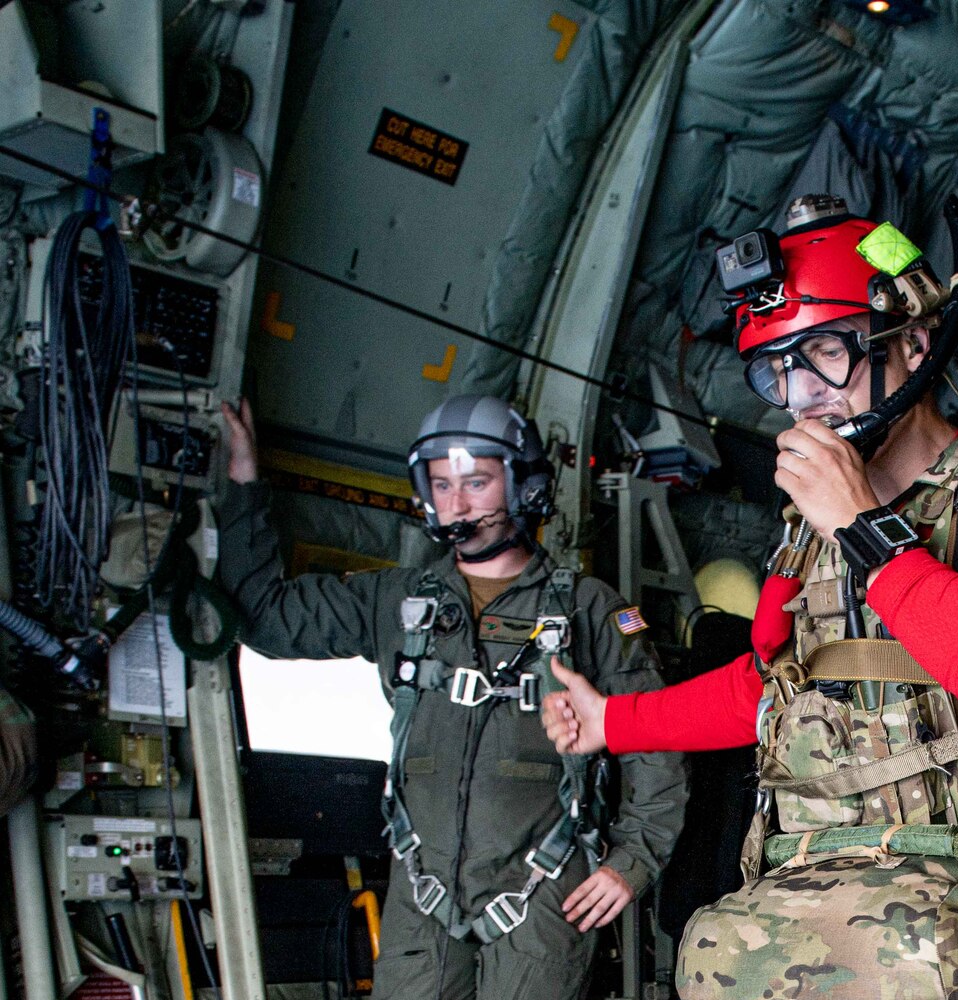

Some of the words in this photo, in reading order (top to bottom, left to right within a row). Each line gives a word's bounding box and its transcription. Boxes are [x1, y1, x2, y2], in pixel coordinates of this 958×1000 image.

[374, 134, 433, 168] EMERGENCY
[435, 159, 457, 177] EXIT
[387, 116, 410, 136] CUT
[411, 127, 437, 149] HERE
[439, 138, 459, 158] FOR
